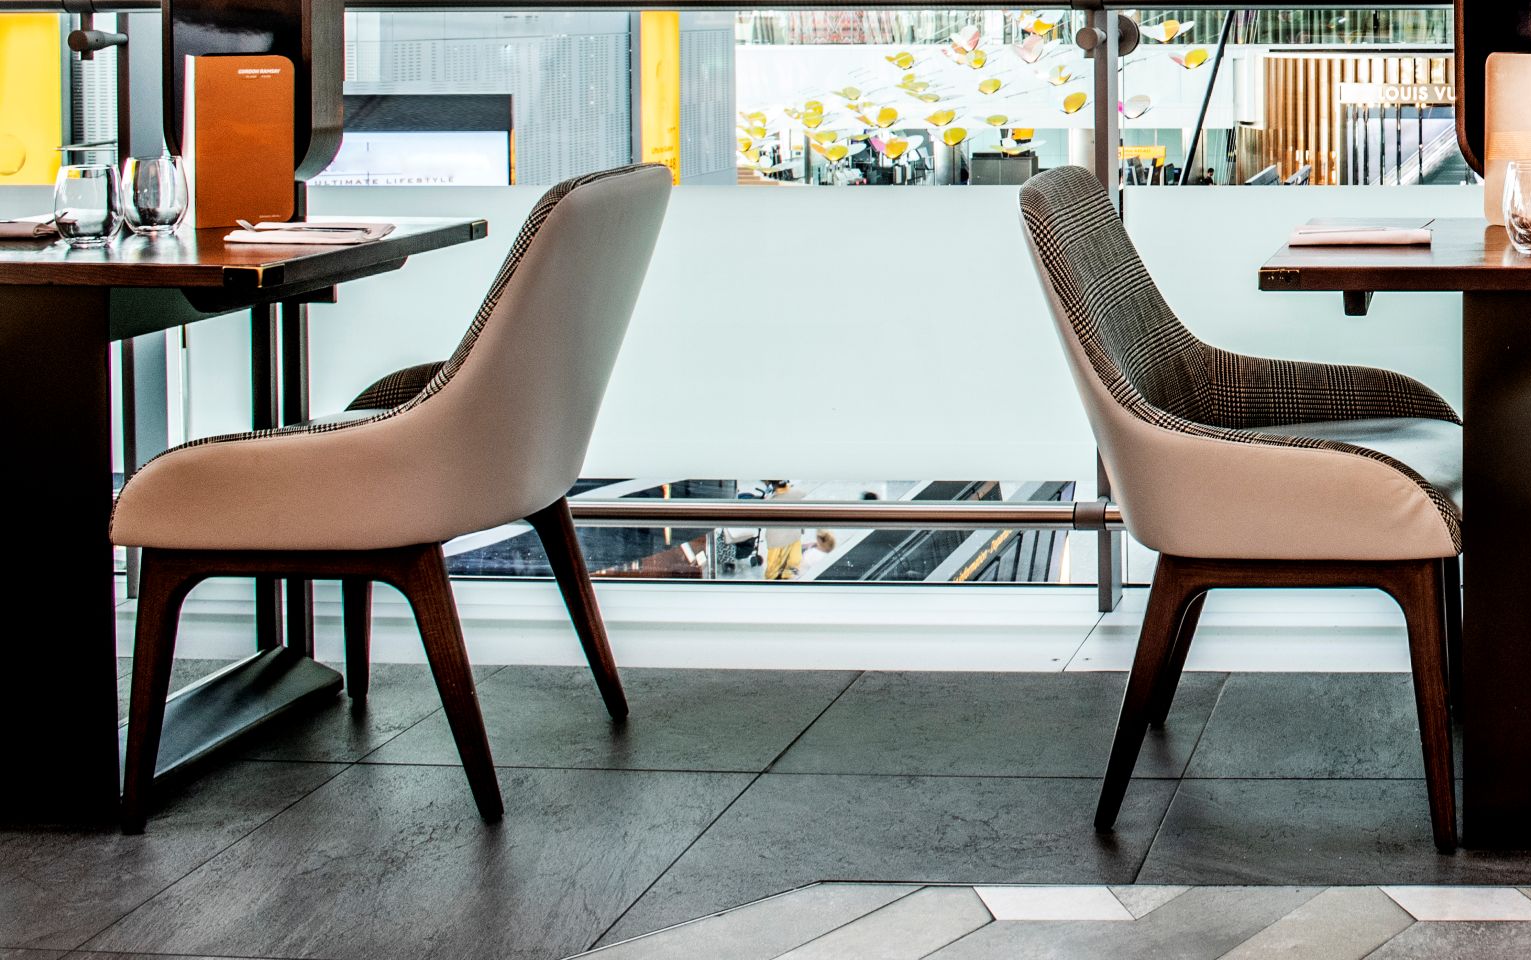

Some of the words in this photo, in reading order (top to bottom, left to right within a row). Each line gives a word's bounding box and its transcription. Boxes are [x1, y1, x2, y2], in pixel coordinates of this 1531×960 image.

[1380, 85, 1429, 101] LOUIS
[314, 178, 379, 186] ULTIMATE
[386, 176, 454, 184] LIFESTYLE
